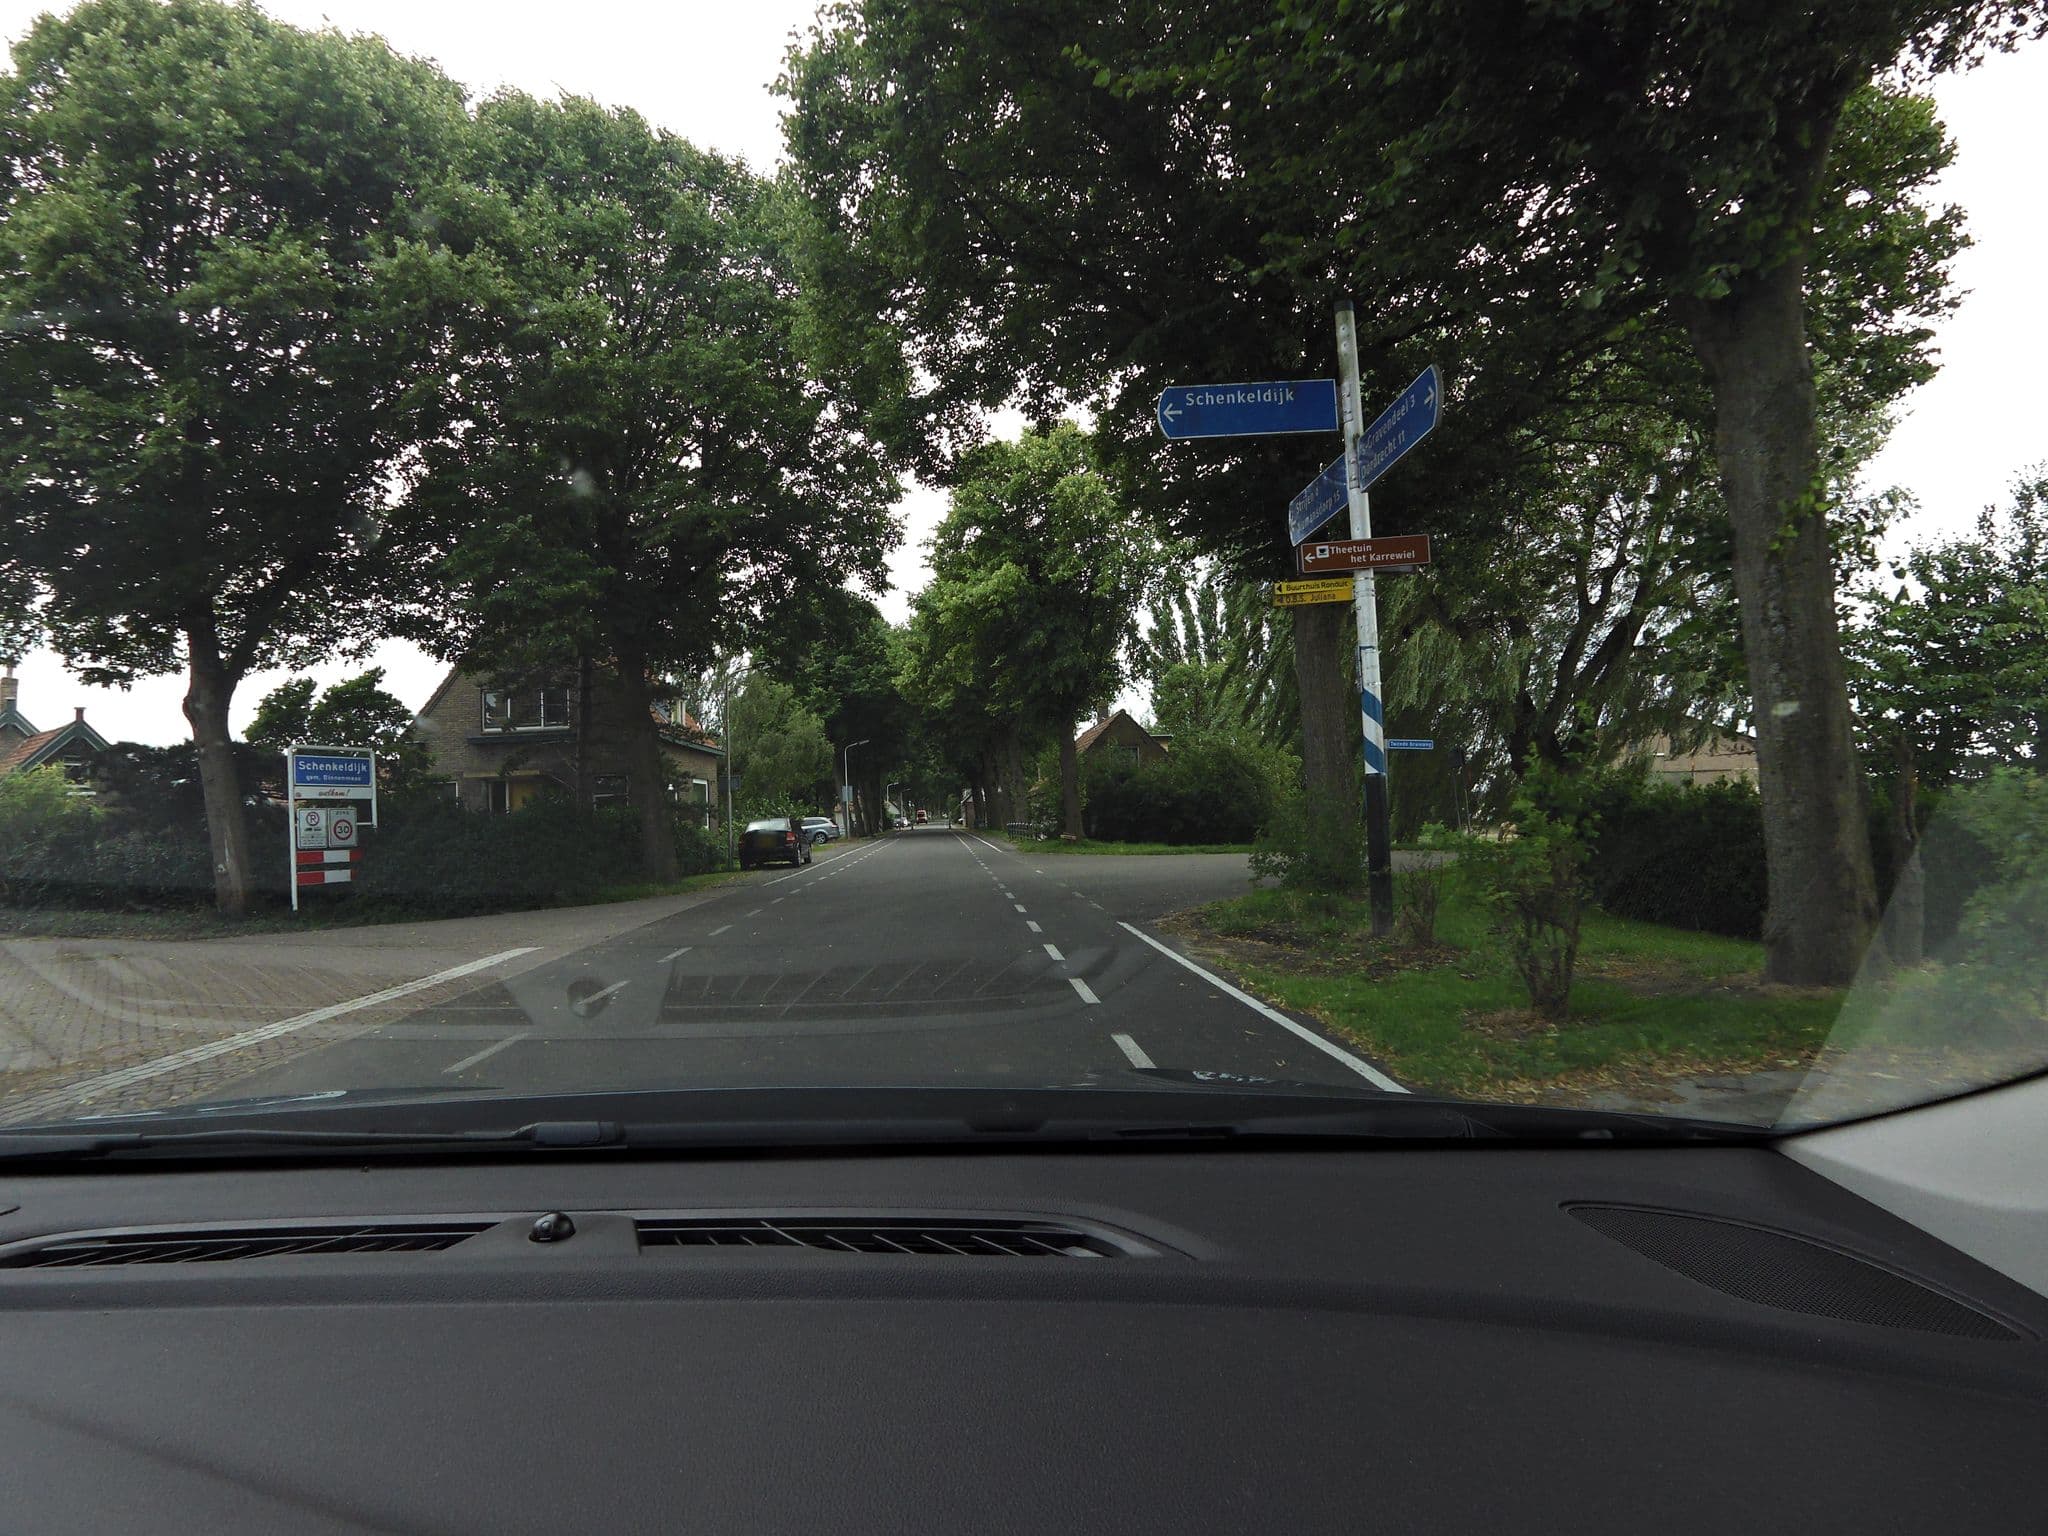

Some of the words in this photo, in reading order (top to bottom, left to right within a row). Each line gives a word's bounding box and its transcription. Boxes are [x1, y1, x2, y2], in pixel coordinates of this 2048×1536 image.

[1185, 388, 1295, 406] Schenkeldijk
[1410, 393, 1416, 409] 3
[1398, 430, 1406, 445] 11
[1329, 543, 1372, 555] Theetuin
[1350, 553, 1367, 564] het
[1369, 549, 1416, 562] Karrewiel
[1286, 583, 1320, 592] Buurthuis
[298, 760, 368, 775] Schenkeldijk
[337, 825, 350, 834] 30
